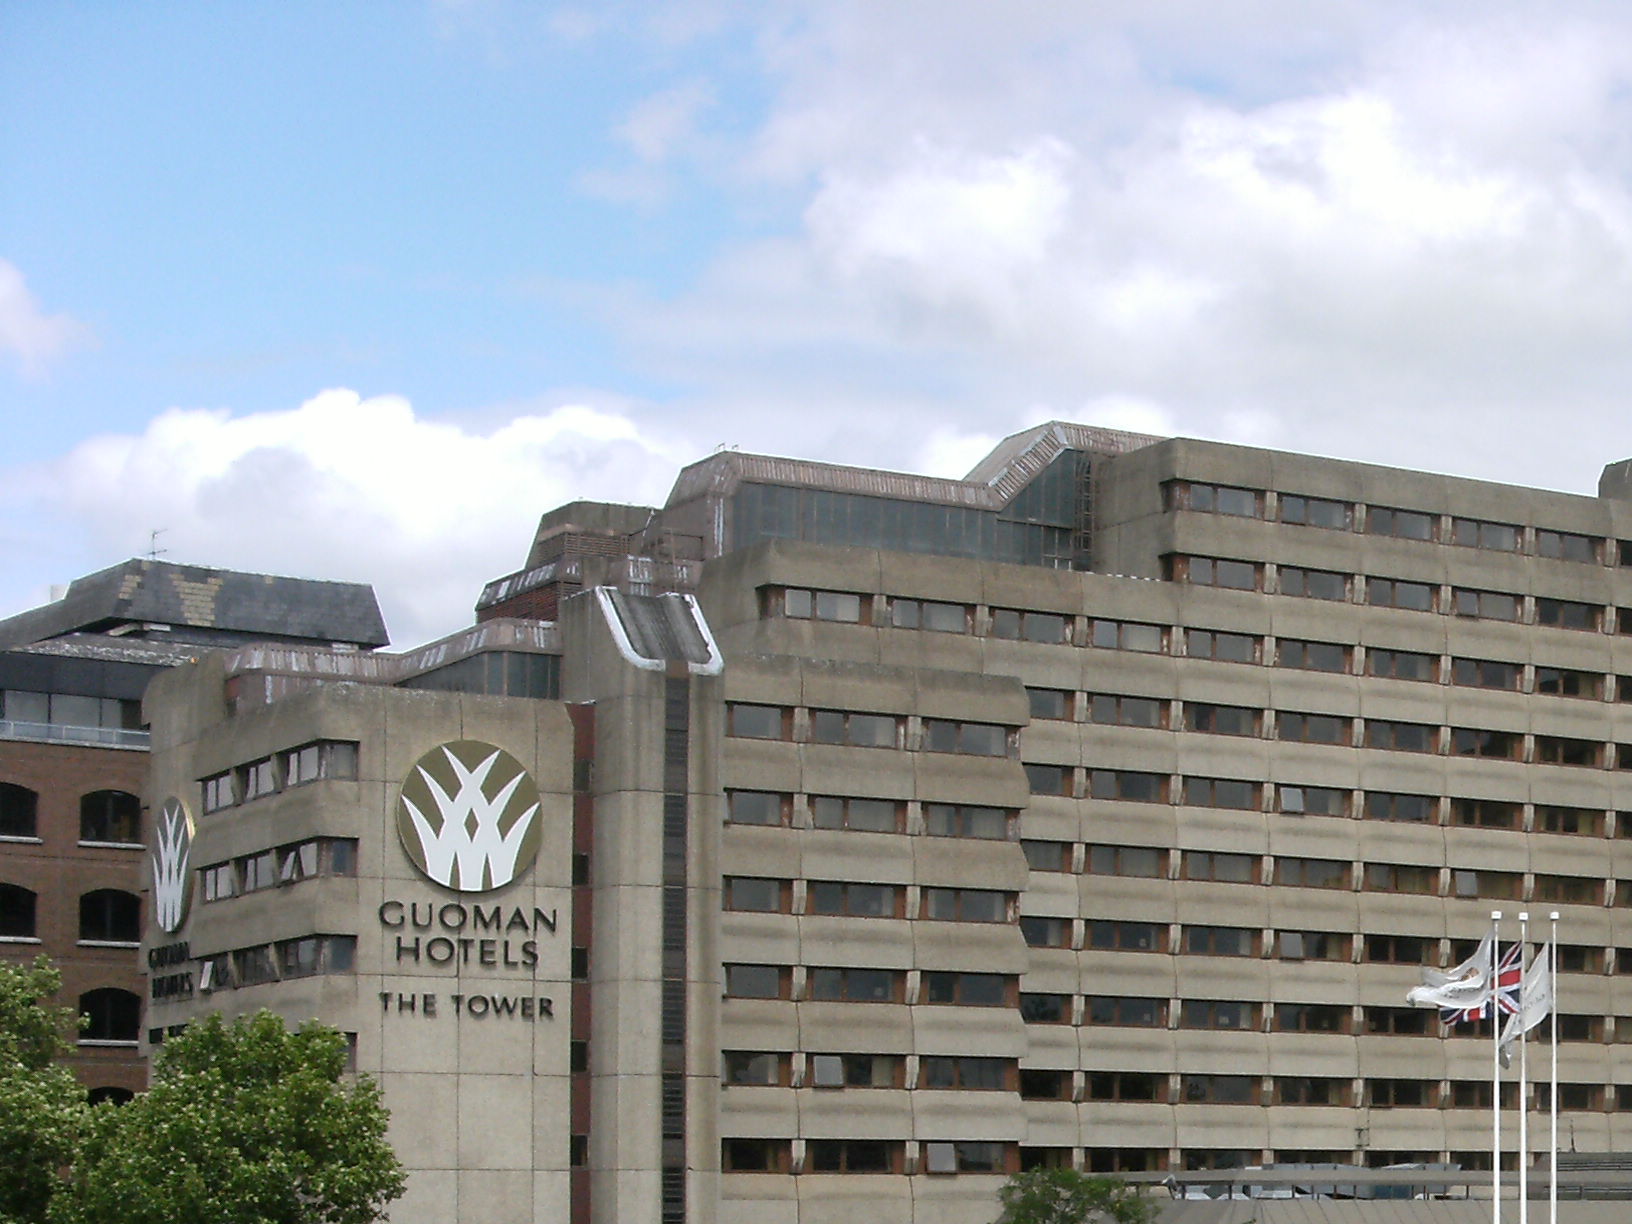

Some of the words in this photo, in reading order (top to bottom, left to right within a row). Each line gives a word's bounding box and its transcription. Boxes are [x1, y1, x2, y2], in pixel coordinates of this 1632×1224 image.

[379, 901, 557, 933] GUOMAN
[396, 936, 539, 968] HOTELS
[379, 992, 437, 1015] THE
[451, 994, 553, 1019] TOWER
